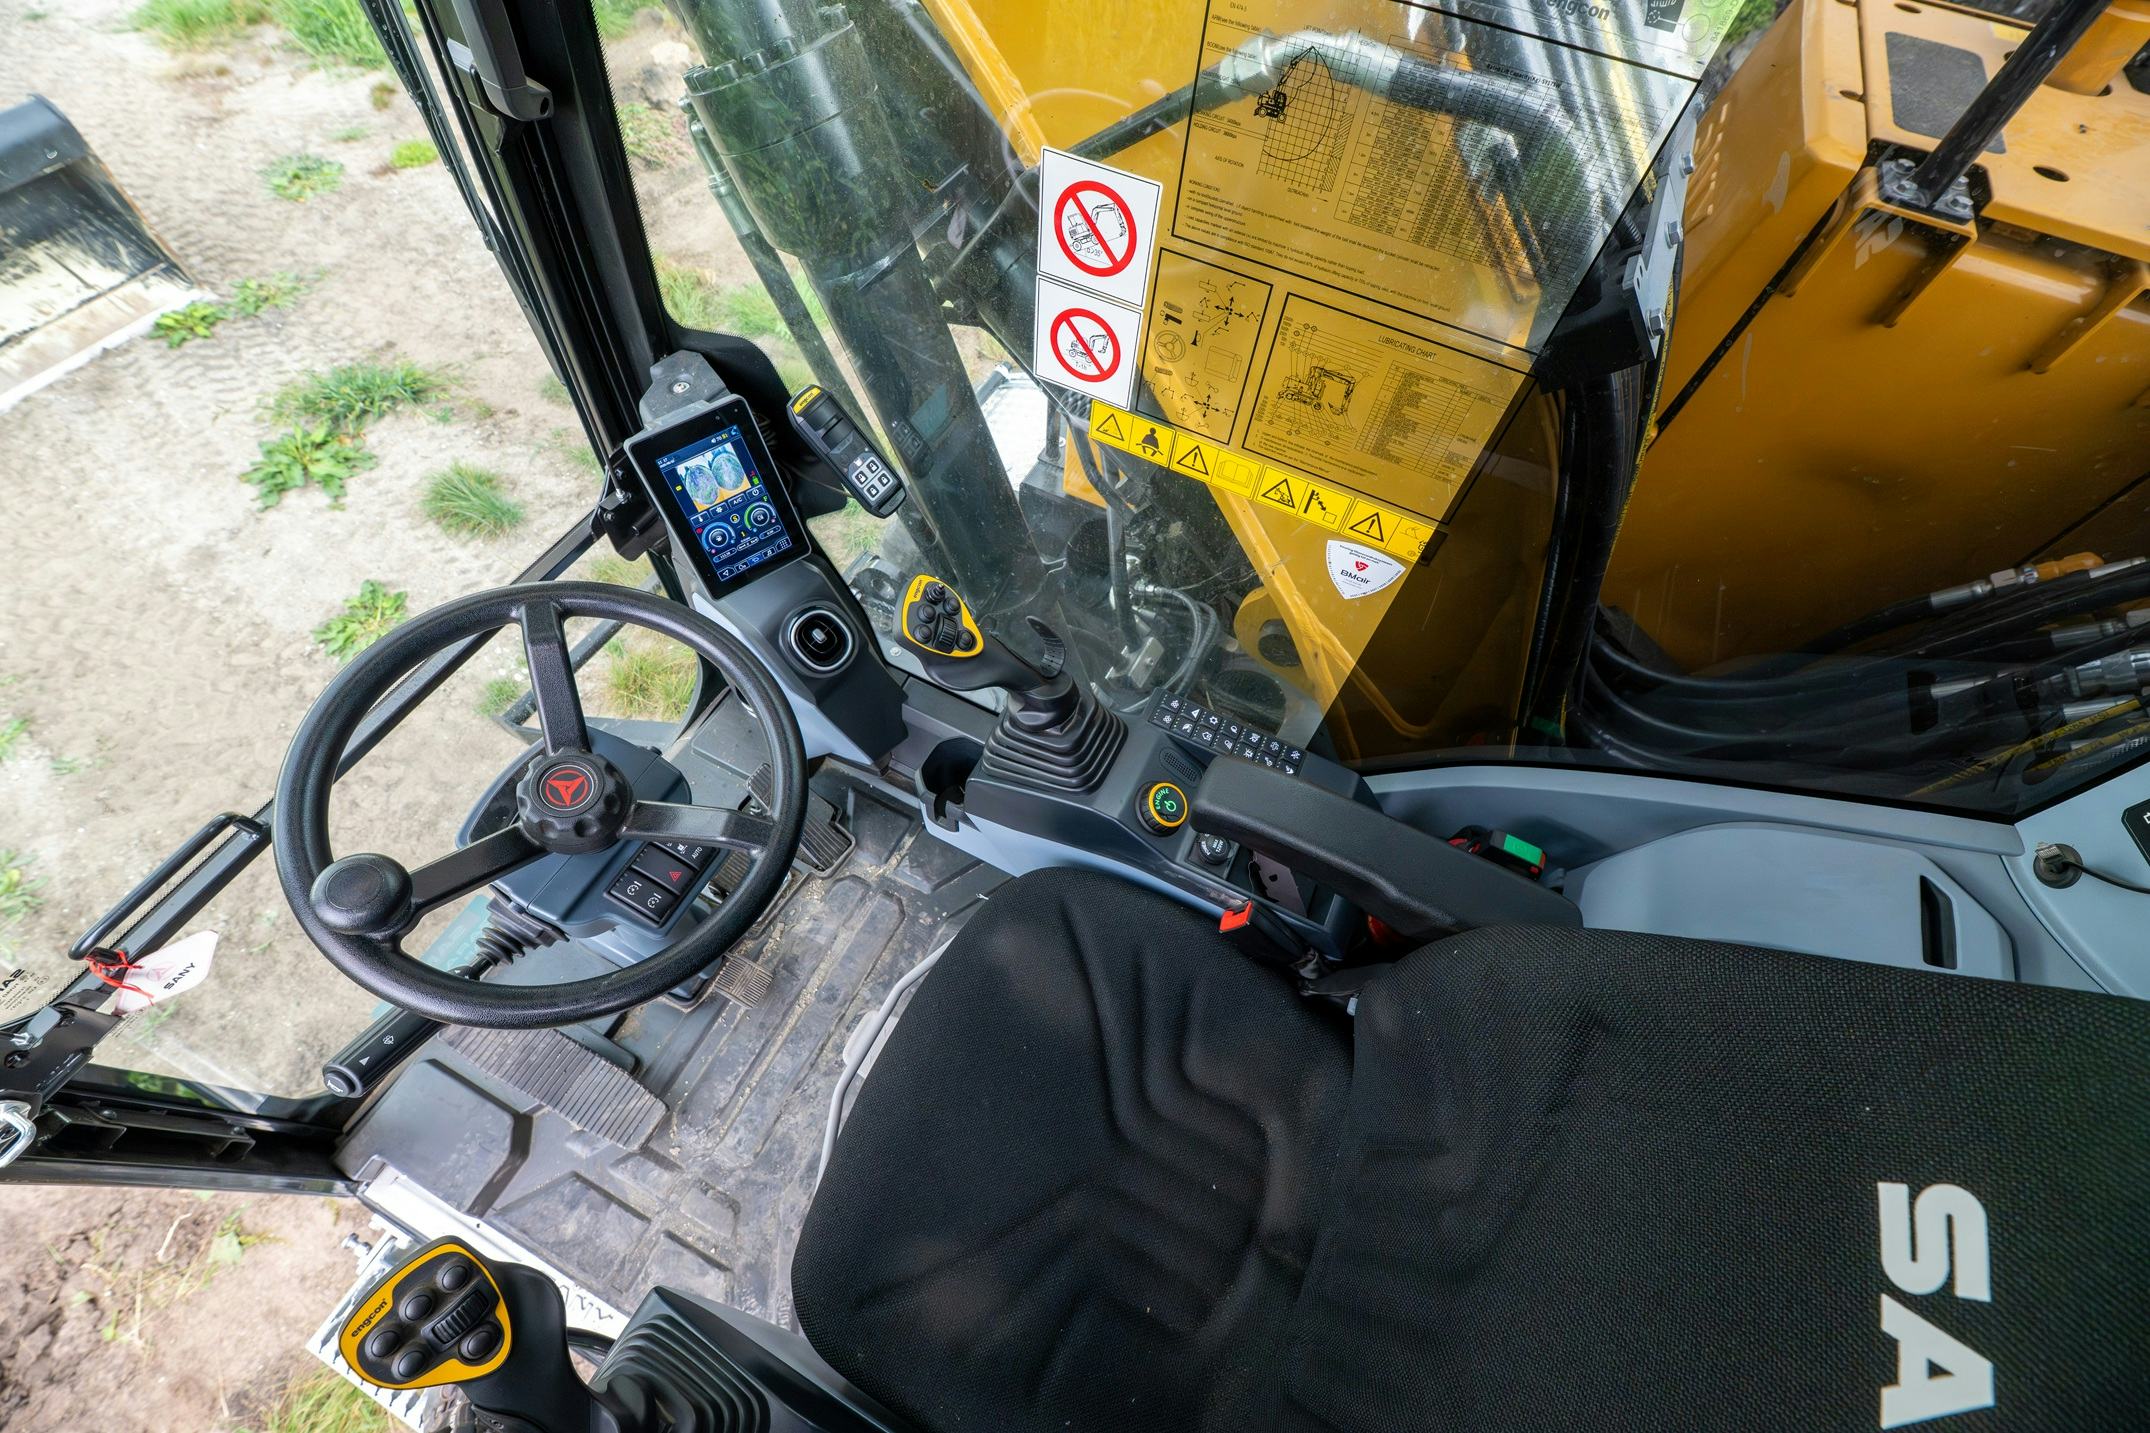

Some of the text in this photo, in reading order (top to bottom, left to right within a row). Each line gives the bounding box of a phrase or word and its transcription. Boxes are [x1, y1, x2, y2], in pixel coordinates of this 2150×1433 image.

[1378, 335, 1438, 361] LUBRICATING CHART
[733, 496, 744, 505] A/C
[1340, 569, 1372, 584] BMair
[1154, 787, 1170, 810] ENGINE
[691, 845, 703, 860] AUTO
[163, 962, 196, 991] SANY
[350, 1299, 387, 1339] engcon
